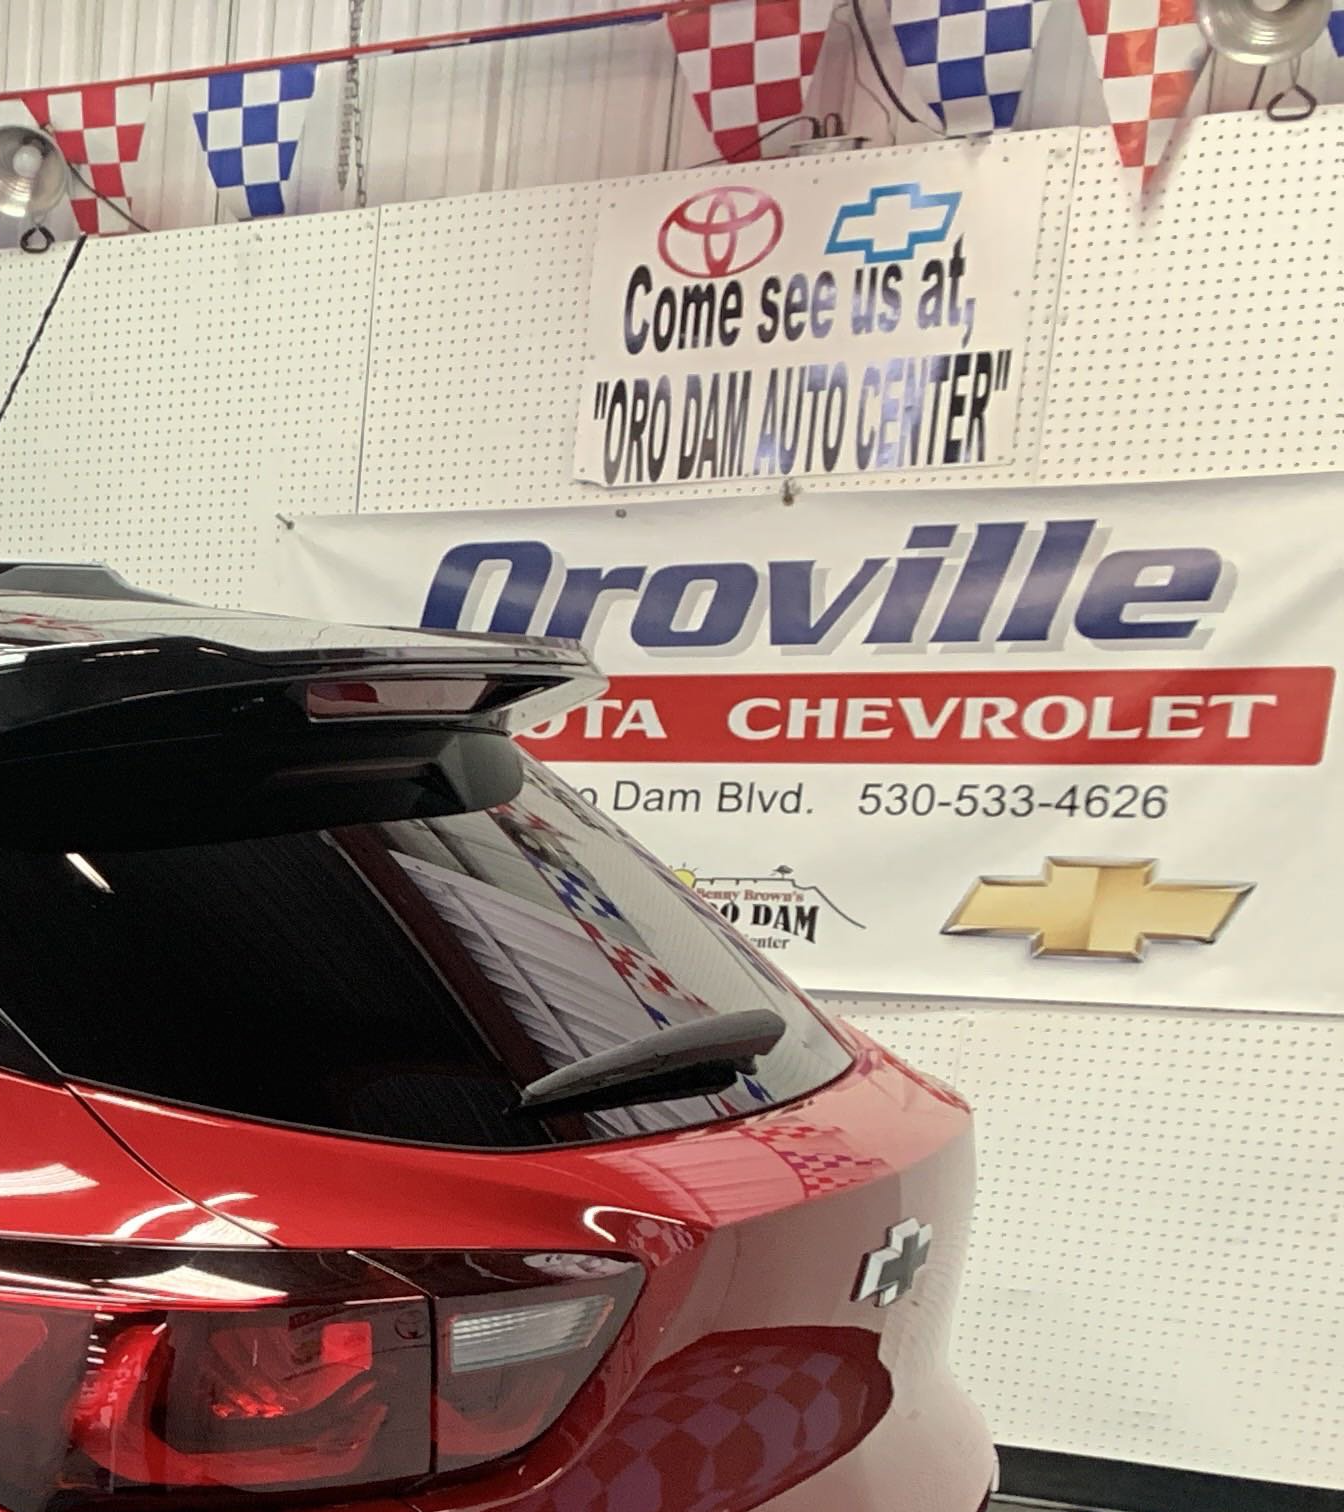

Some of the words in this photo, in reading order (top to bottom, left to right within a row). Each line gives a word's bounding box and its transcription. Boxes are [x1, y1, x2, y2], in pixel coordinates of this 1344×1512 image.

[623, 263, 744, 355] Come
[757, 269, 837, 344] see
[850, 262, 903, 336] us
[915, 232, 977, 347] at,
[593, 375, 673, 484] "ORO
[676, 369, 753, 480] DAM
[752, 361, 849, 475] AUTO
[854, 349, 1013, 470] CENTER"
[419, 519, 1229, 652] Oroville
[727, 694, 1278, 741] CHEVROLET
[612, 780, 702, 812] Dam
[717, 780, 814, 816] Blvd.
[857, 783, 1169, 819] 530-533-4626
[744, 889, 804, 901] Brown's
[750, 903, 820, 944] DAM
